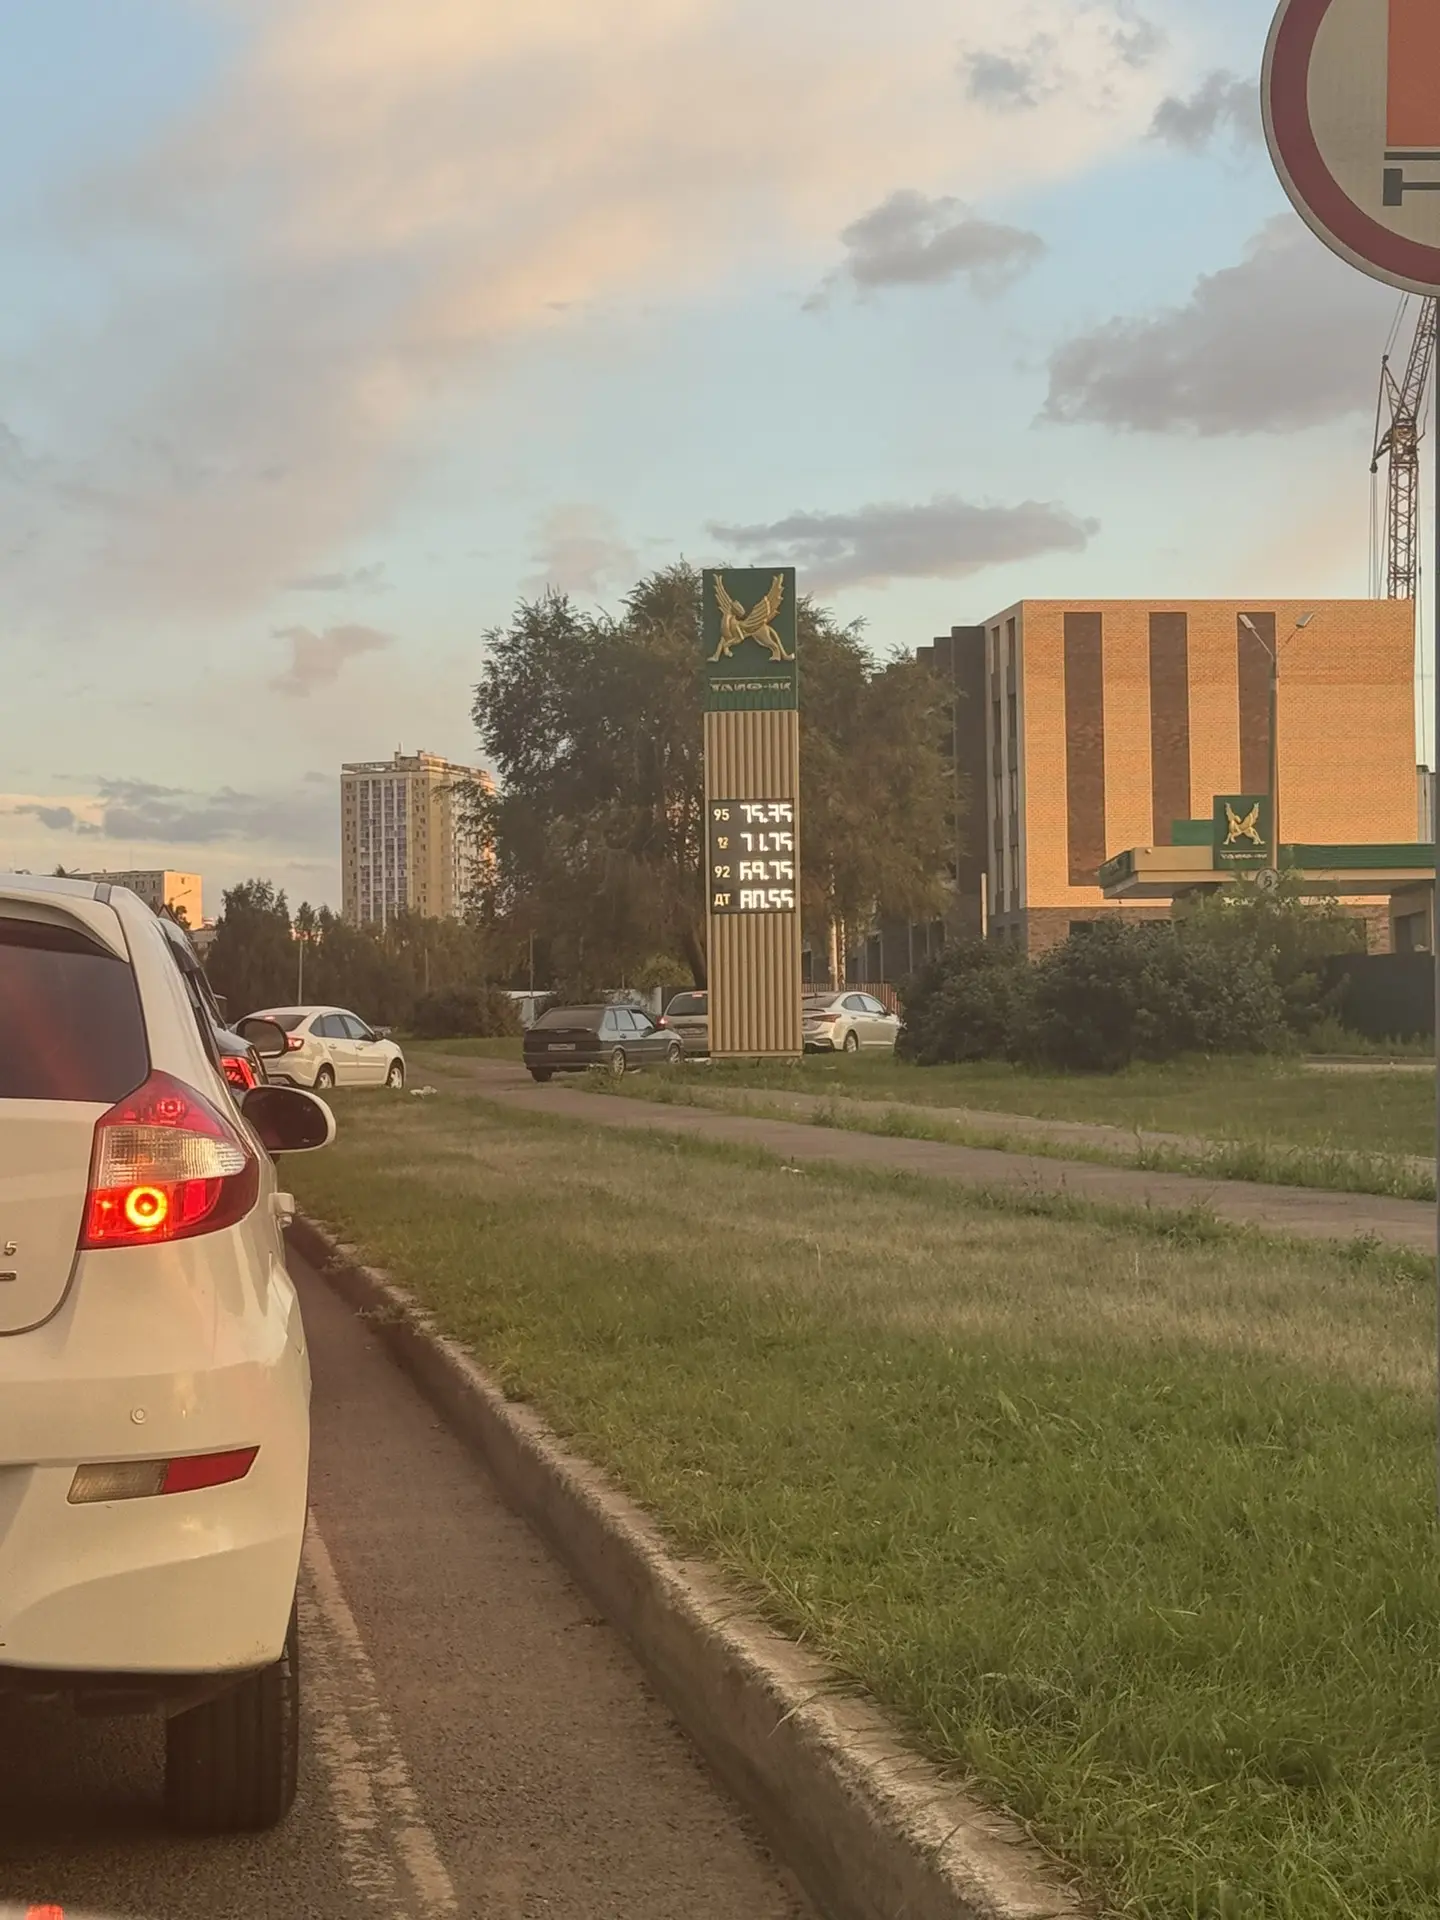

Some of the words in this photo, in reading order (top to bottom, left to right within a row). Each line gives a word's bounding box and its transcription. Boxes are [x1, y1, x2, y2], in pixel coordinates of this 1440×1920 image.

[713, 808, 730, 821] 95
[714, 865, 731, 878] 92
[714, 893, 731, 906] ДТ
